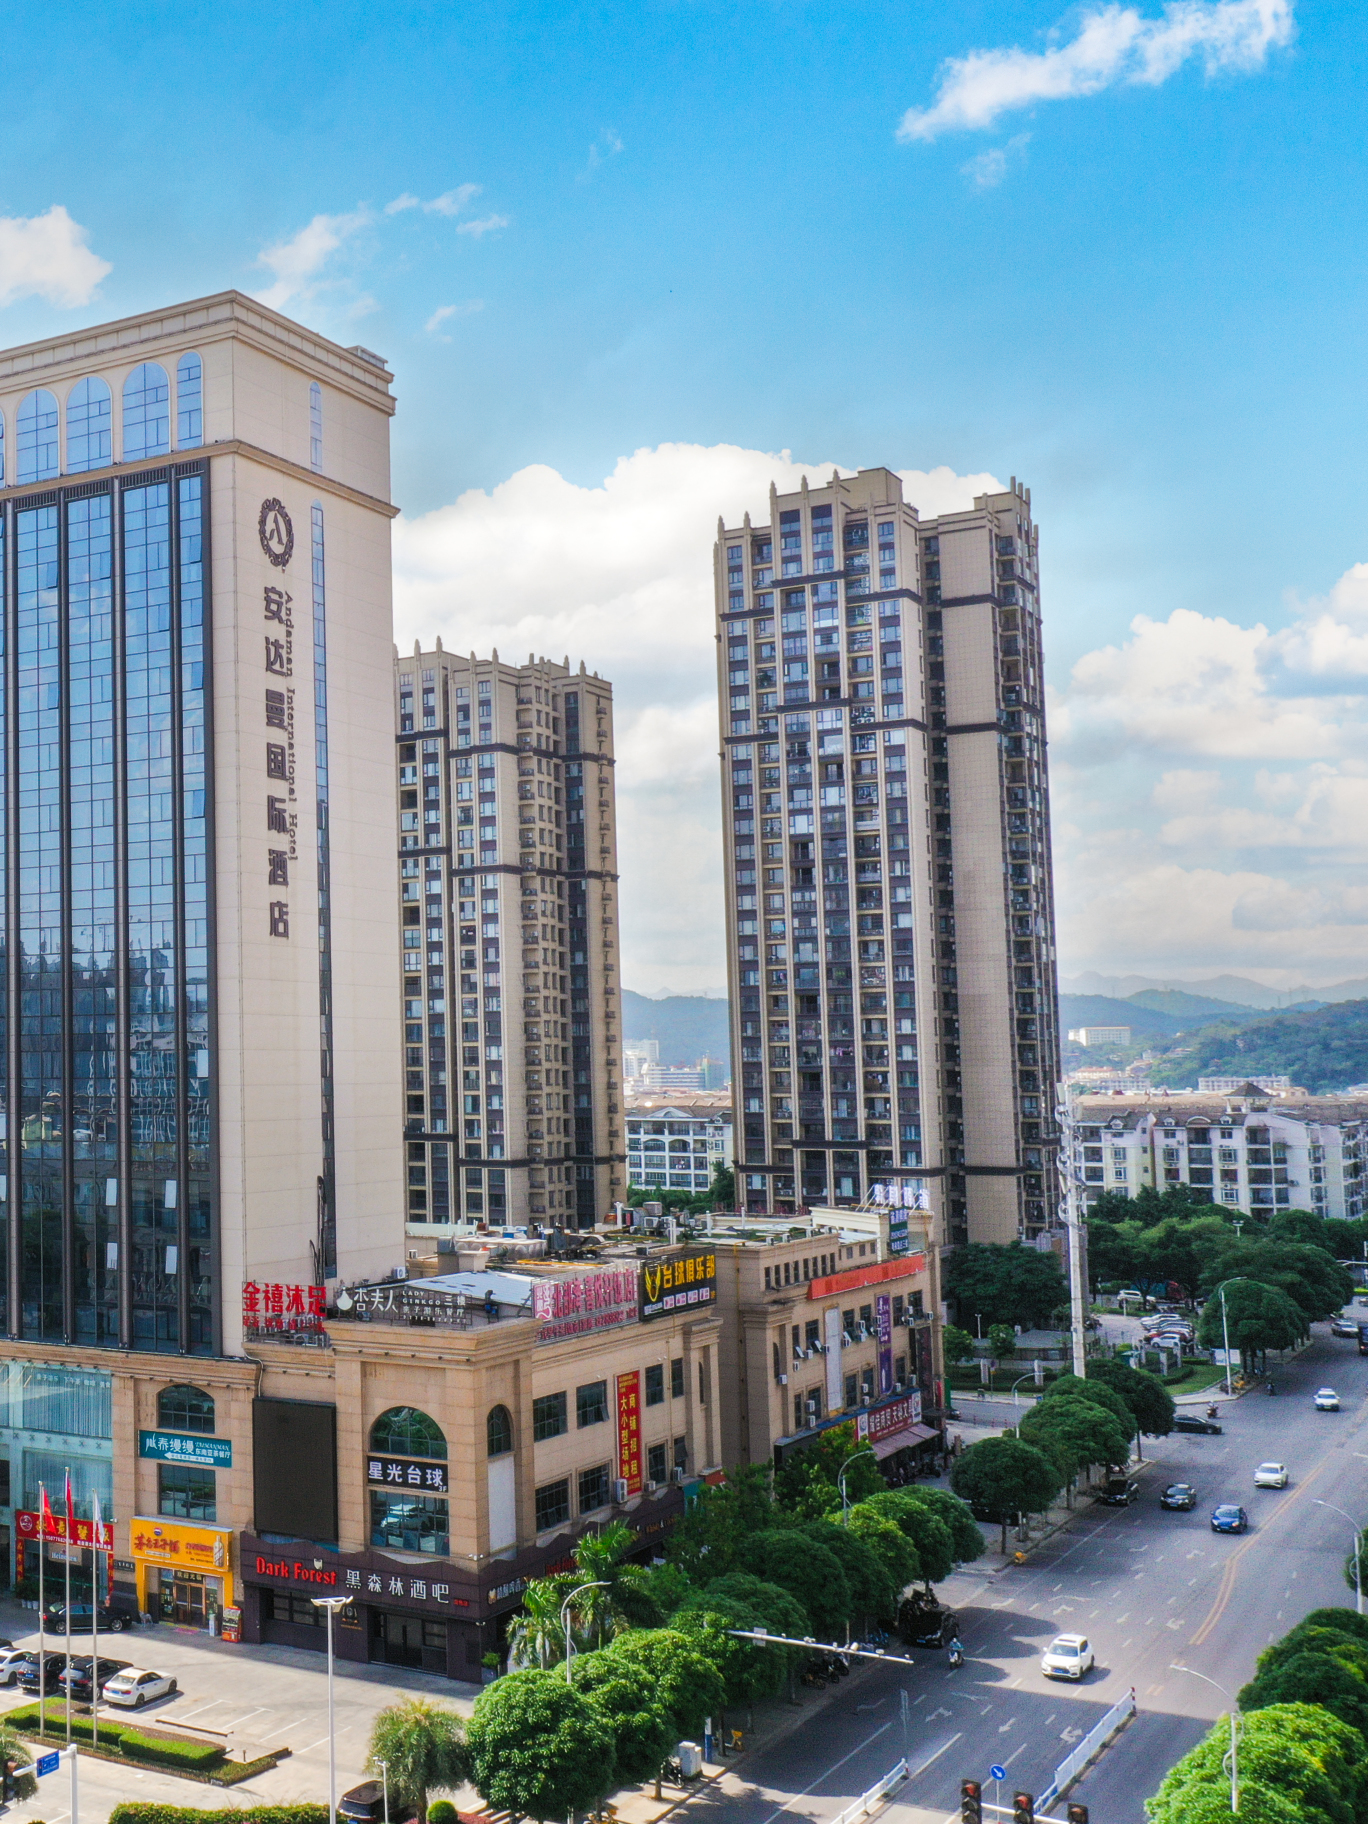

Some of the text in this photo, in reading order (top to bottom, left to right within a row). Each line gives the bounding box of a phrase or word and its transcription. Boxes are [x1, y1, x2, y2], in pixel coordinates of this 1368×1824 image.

[264, 586, 290, 938] 安达曼国际酒店
[288, 813, 298, 861] Hotel
[663, 1254, 716, 1289] 台球俱乐部
[242, 1282, 327, 1317] 金禧沐足
[368, 1461, 444, 1488] 星光台球
[438, 1484, 448, 1493] 3F
[256, 1556, 337, 1585] Dark Forest
[345, 1568, 450, 1604] 黑森林酒吧
